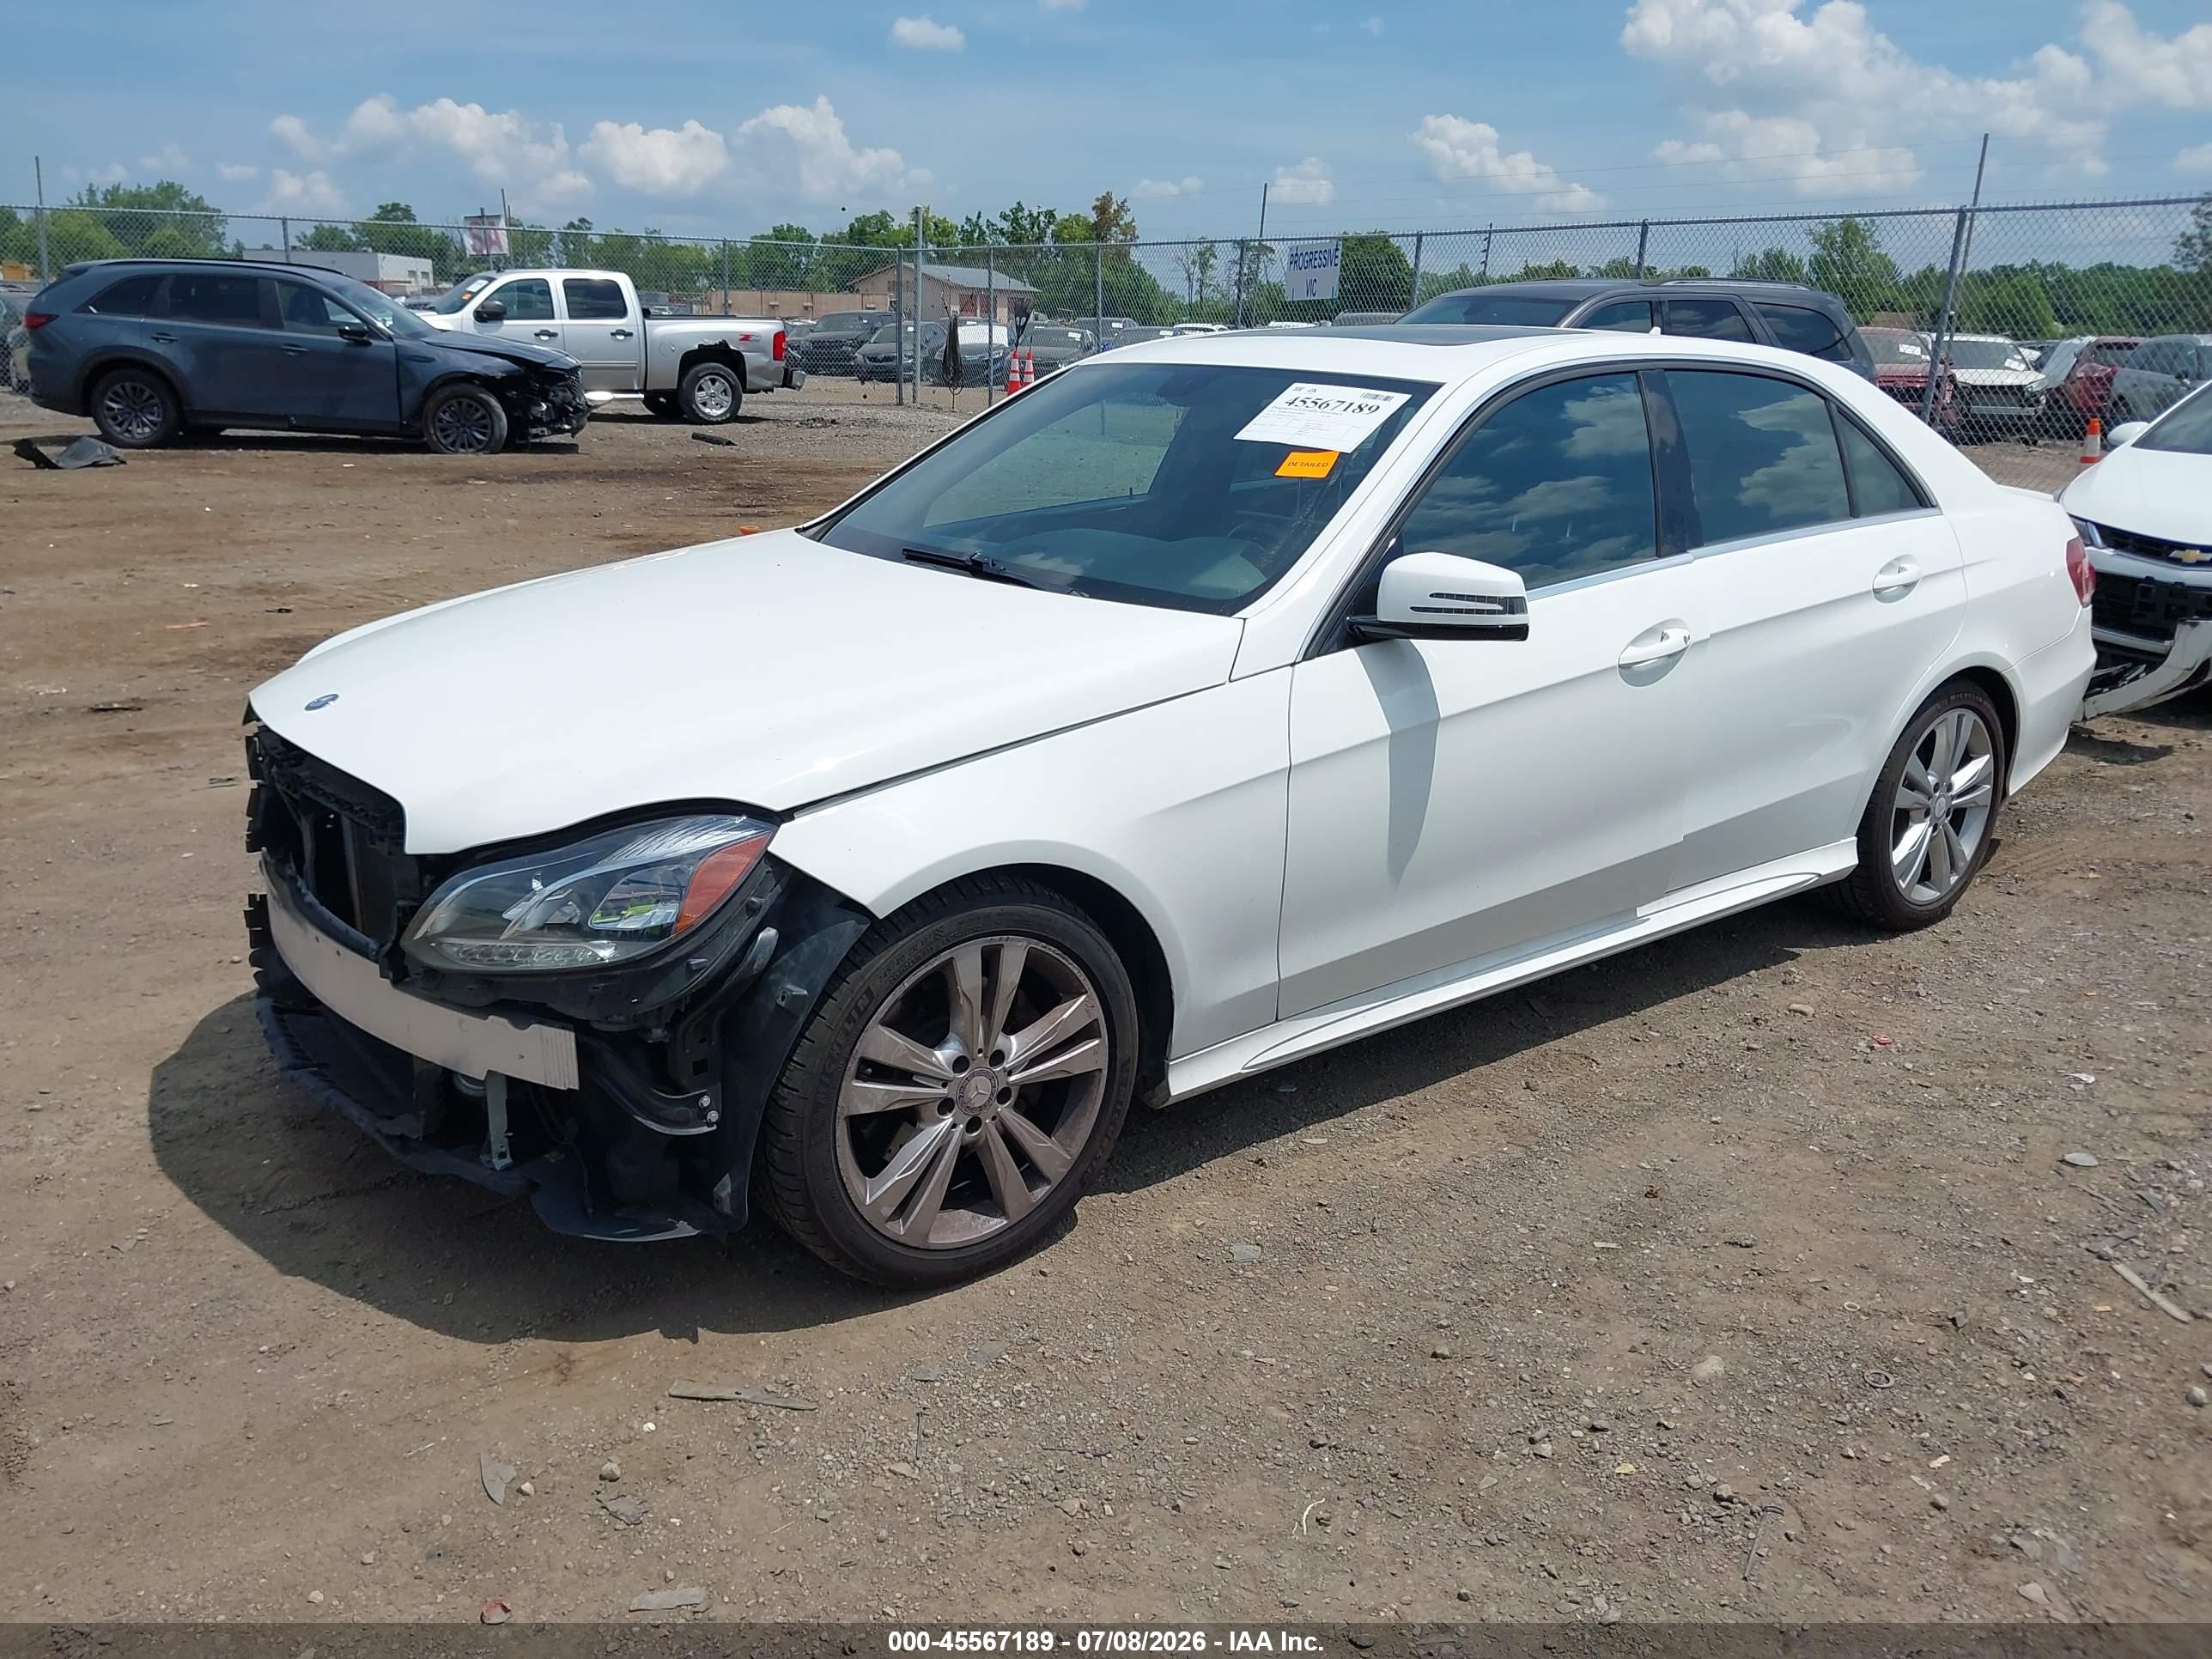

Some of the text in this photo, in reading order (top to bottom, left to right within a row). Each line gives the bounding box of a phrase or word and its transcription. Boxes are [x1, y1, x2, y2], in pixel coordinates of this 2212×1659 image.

[1289, 247, 1340, 271] PROGRESSIVE
[1306, 278, 1317, 297] VIC
[1285, 396, 1381, 416] 45567189
